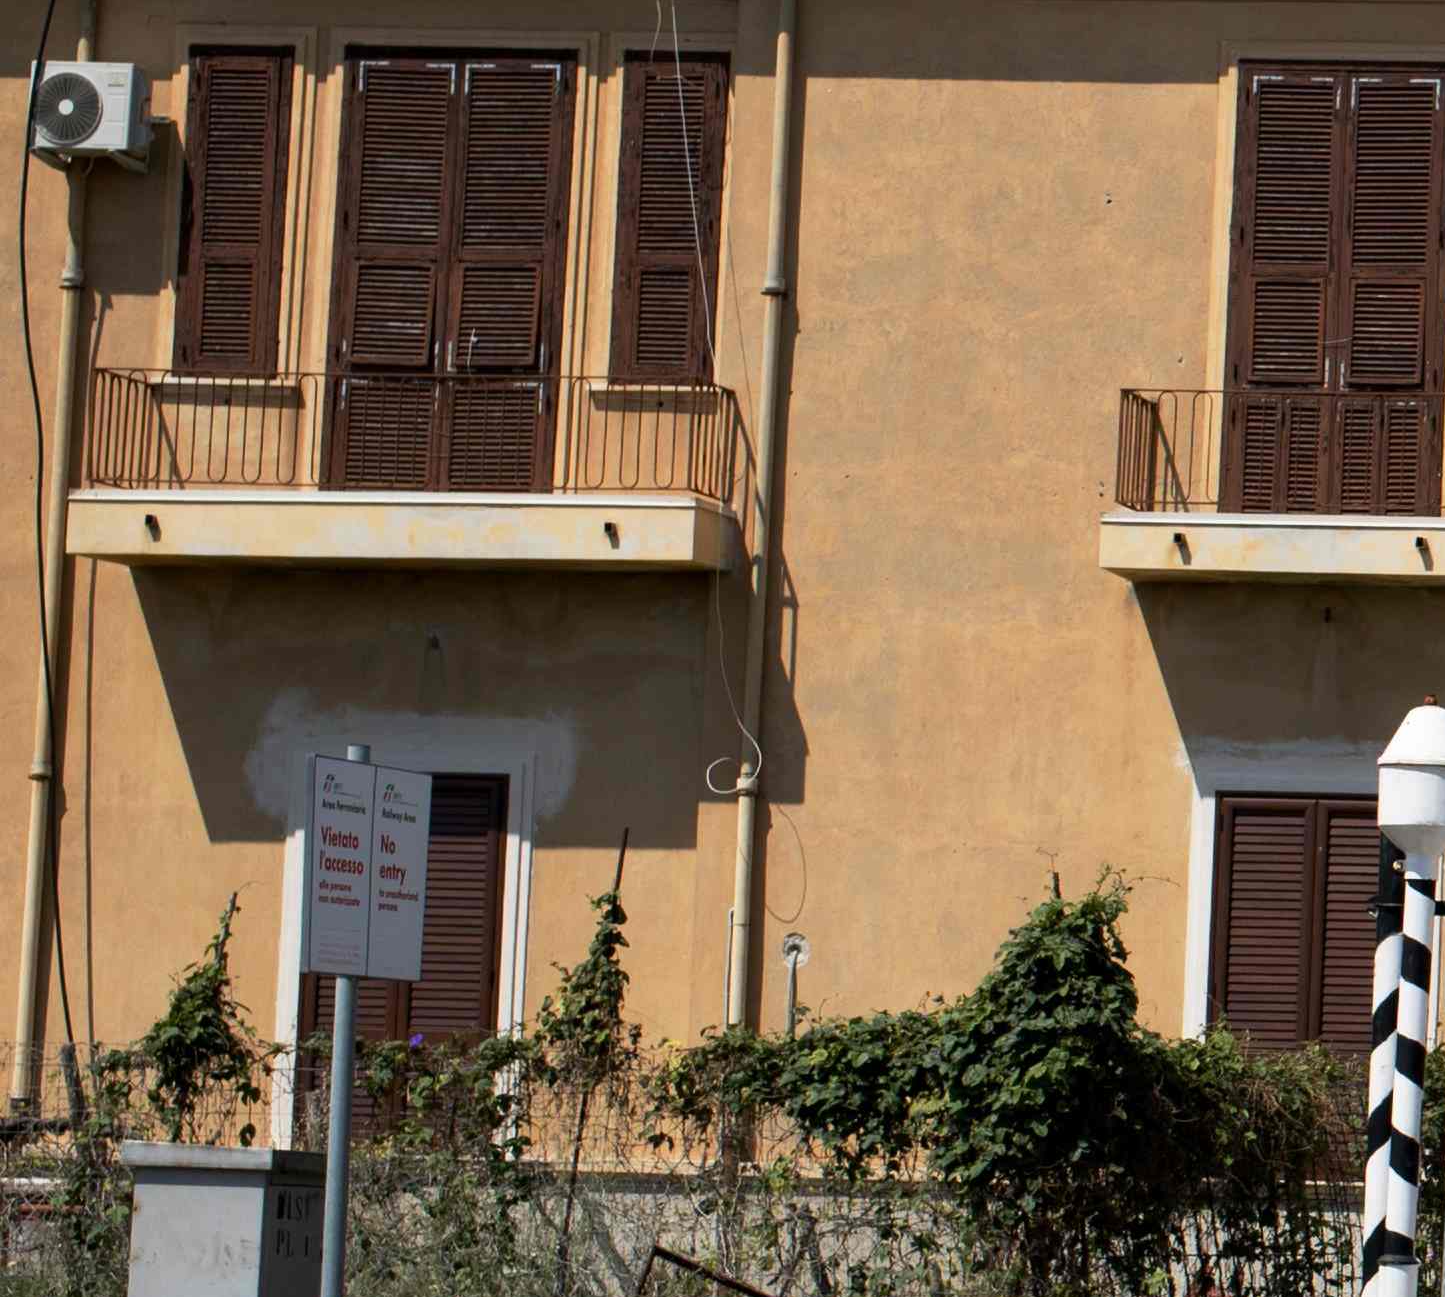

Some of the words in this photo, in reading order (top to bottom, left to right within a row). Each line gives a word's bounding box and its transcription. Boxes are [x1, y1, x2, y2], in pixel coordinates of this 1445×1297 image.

[321, 826, 359, 849] Vietato
[381, 834, 396, 855] No
[319, 850, 364, 874] l'accesso
[379, 863, 407, 886] entry
